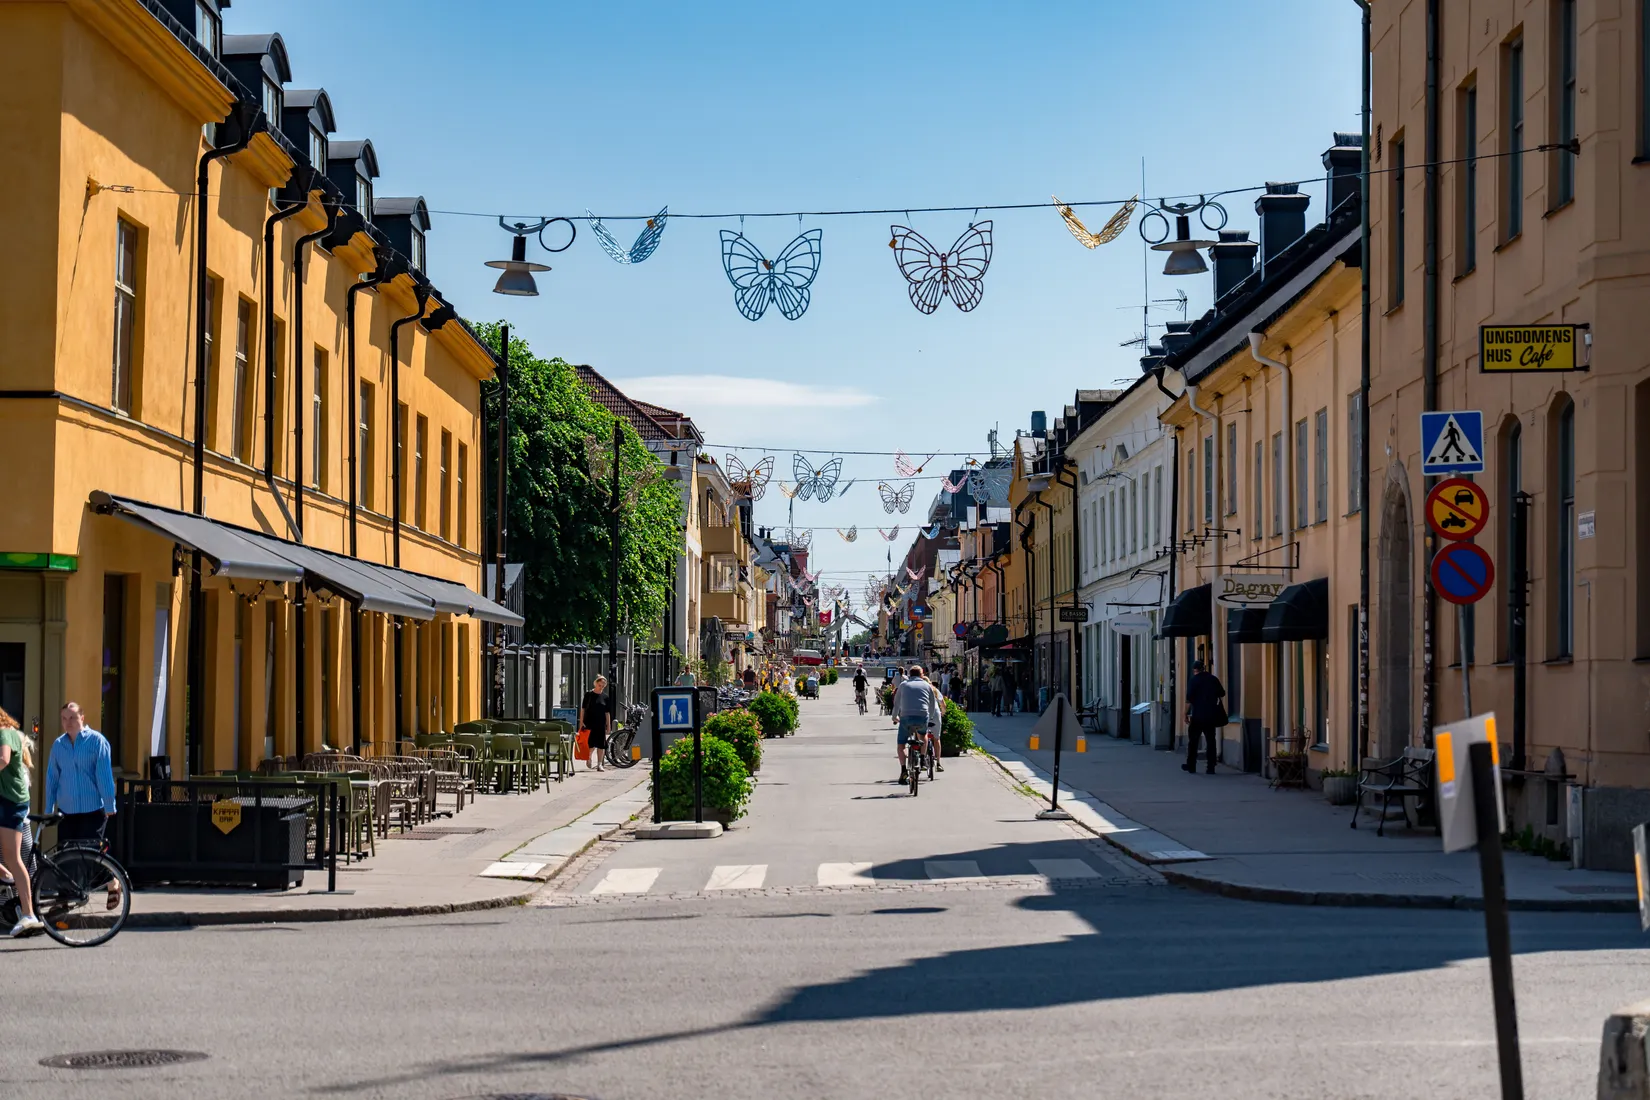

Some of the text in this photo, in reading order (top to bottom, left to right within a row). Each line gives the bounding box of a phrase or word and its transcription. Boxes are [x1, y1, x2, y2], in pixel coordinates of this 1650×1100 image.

[1485, 329, 1571, 344] UNGDOMENS
[1486, 344, 1555, 367] HUS Café
[1222, 578, 1284, 600] Dagny
[213, 808, 240, 816] KAPPA
